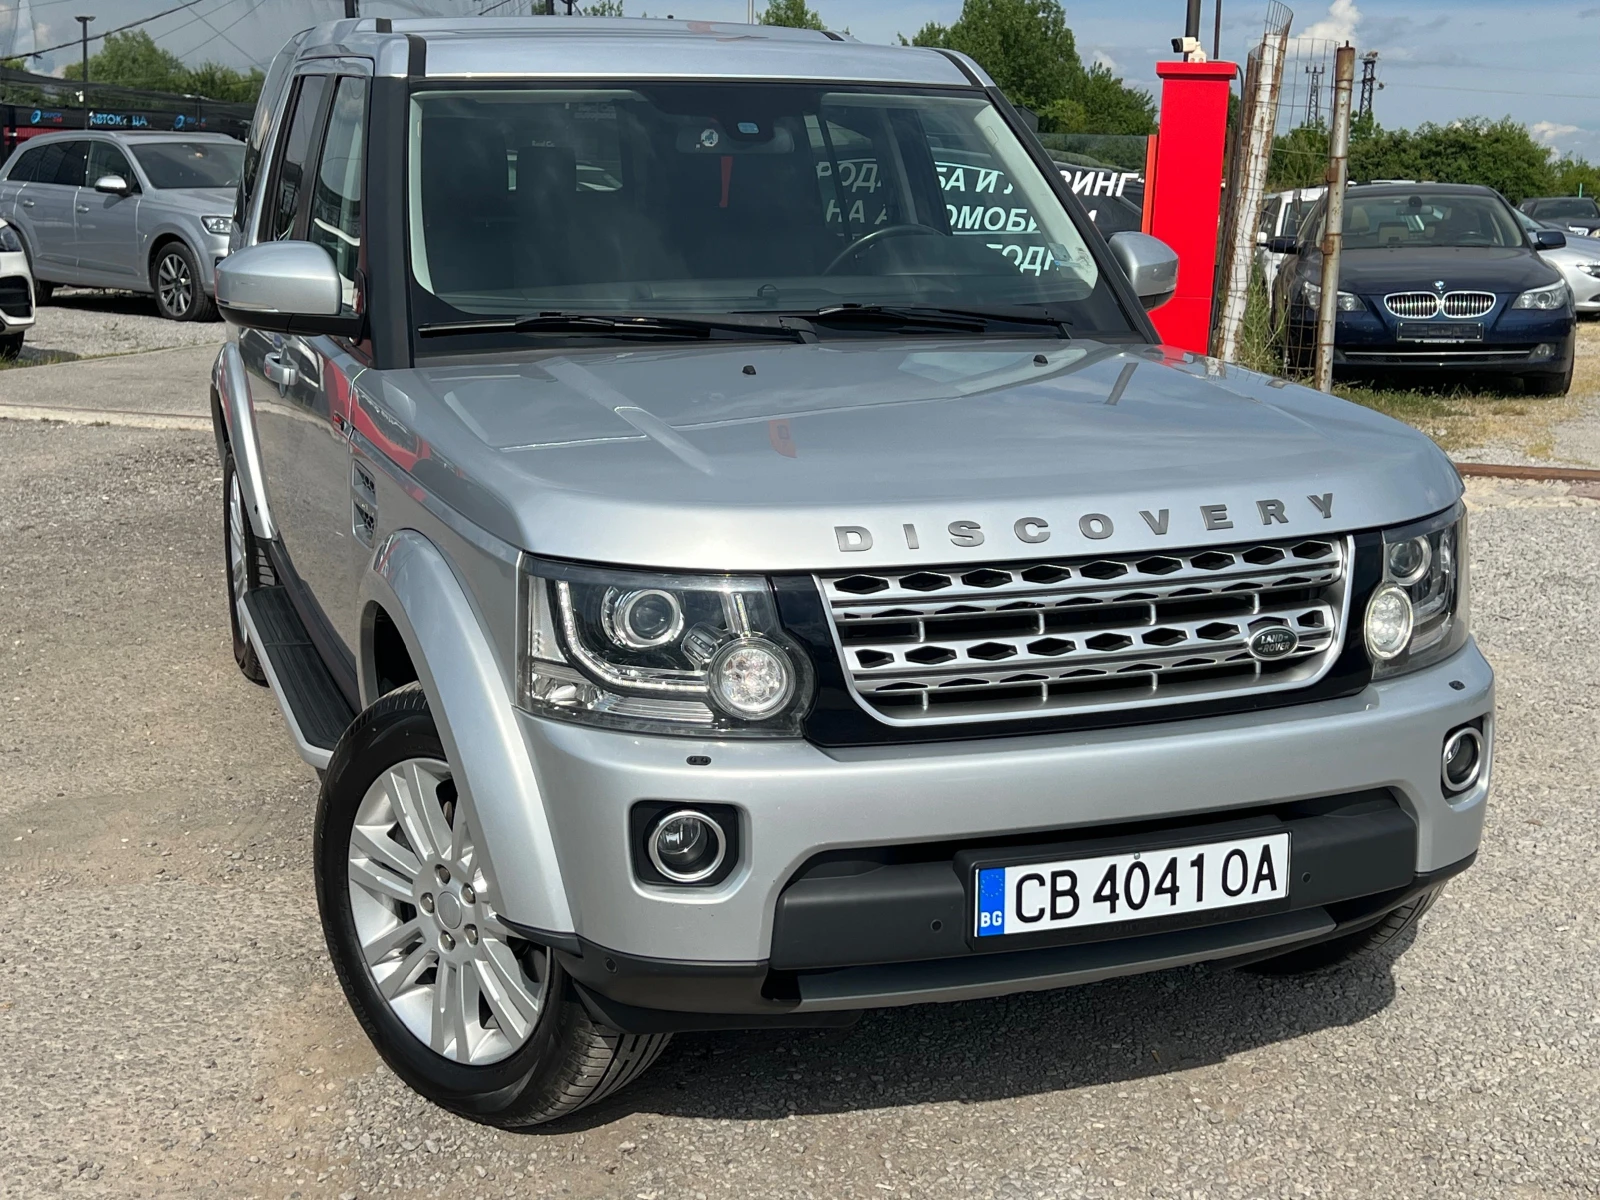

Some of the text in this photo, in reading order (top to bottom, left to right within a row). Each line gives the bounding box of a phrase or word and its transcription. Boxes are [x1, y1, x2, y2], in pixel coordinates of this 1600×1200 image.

[834, 493, 1333, 552] DISCOVERY
[1261, 634, 1284, 645] LAND
[1263, 642, 1290, 652] ROVER
[1015, 869, 1080, 923] CB
[1093, 853, 1205, 914] 4041
[1221, 843, 1278, 897] OA
[980, 911, 1002, 928] BG
